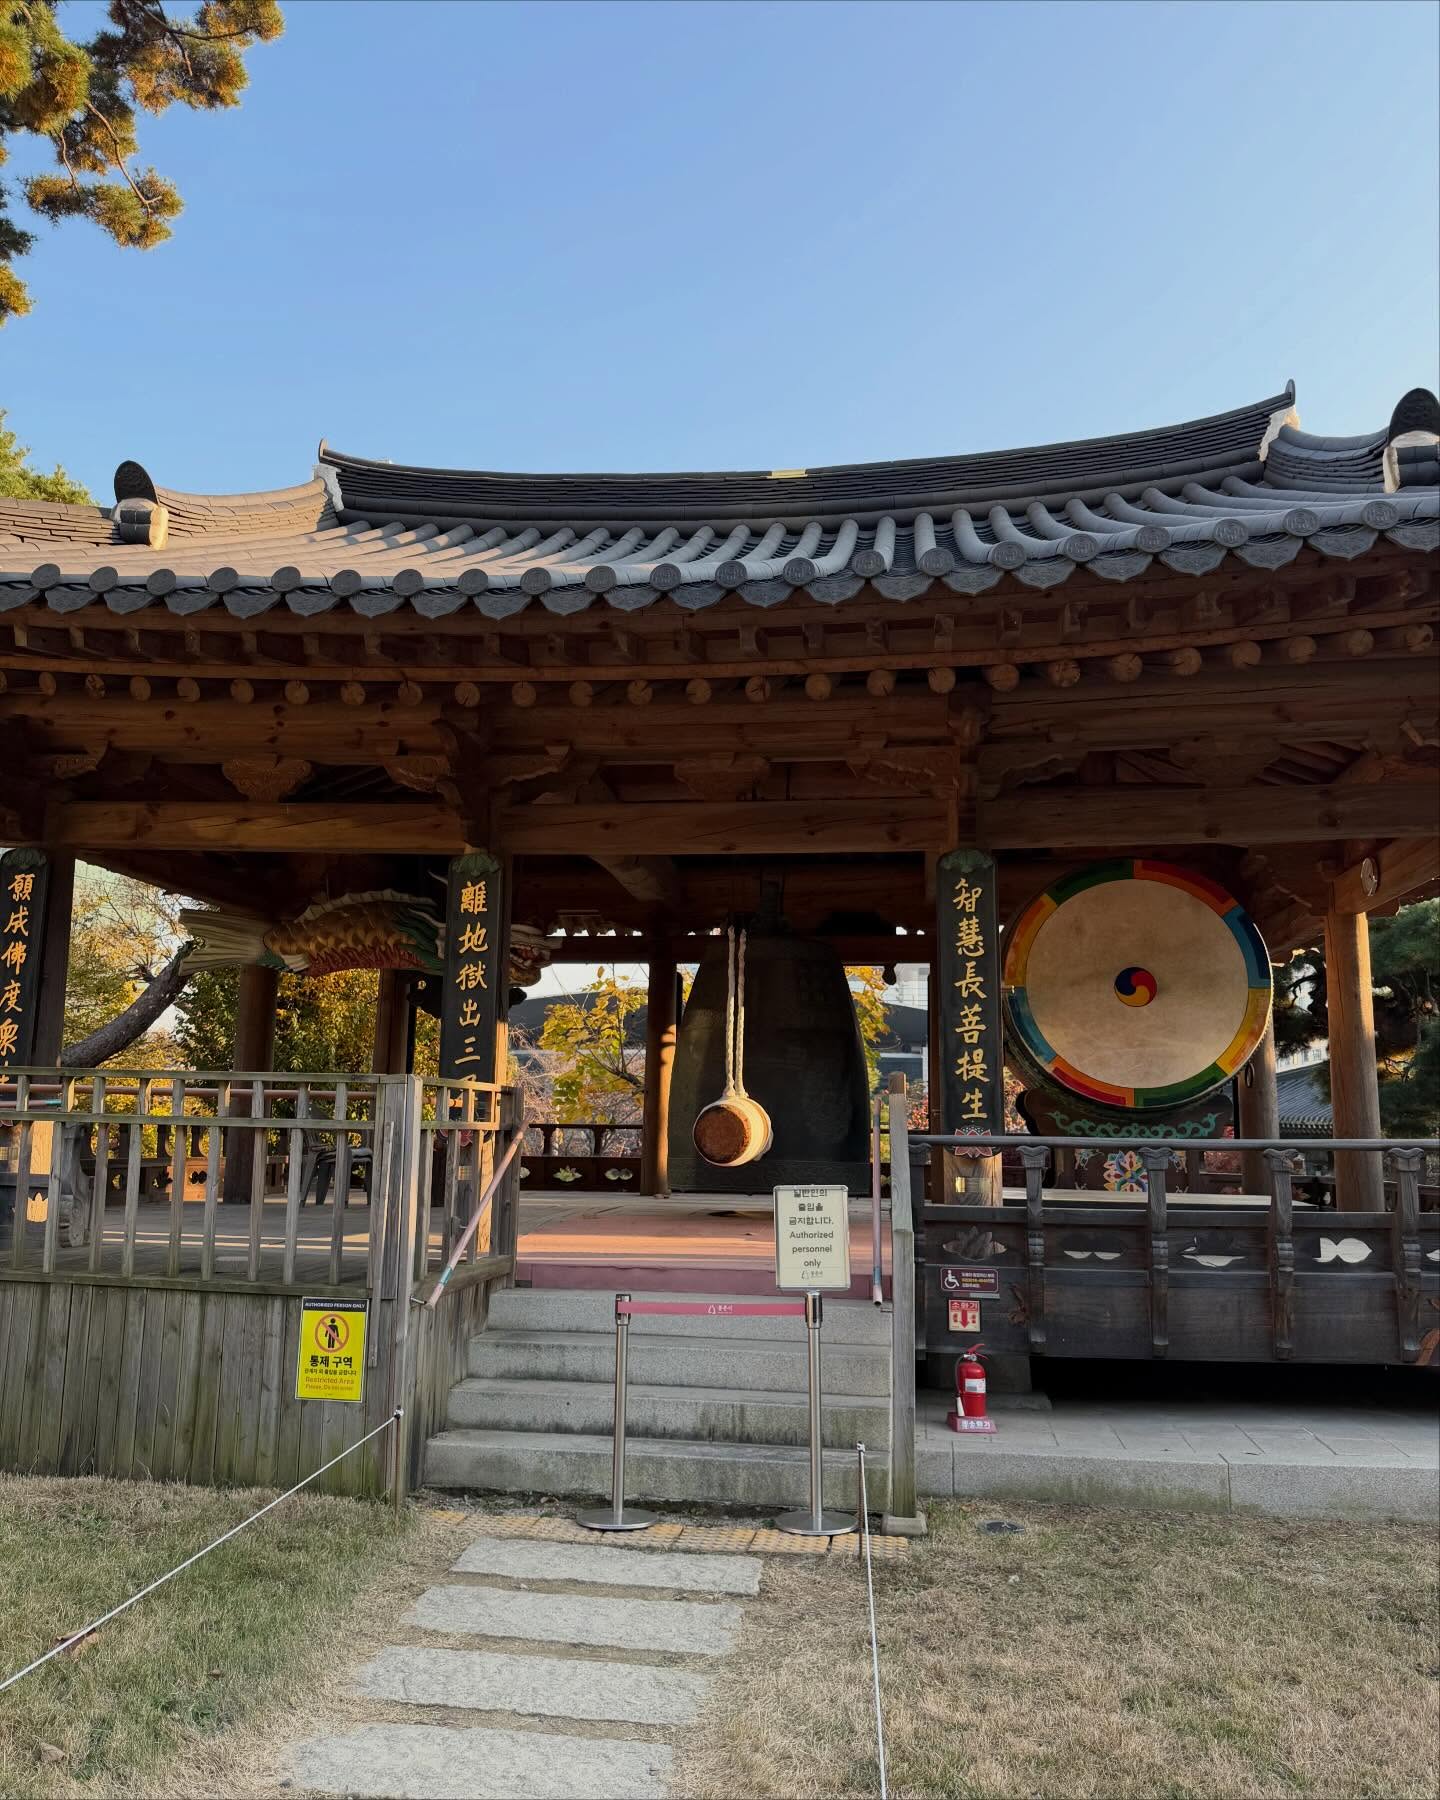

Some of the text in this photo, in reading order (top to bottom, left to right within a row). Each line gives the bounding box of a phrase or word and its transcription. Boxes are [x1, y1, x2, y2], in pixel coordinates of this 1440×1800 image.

[455, 881, 488, 1100] 離地獄出三
[953, 878, 990, 1120] 智慧長菩提生
[789, 1216, 834, 1225] 금지합니다.
[789, 1231, 834, 1239] Authorized
[792, 1245, 833, 1254] personnel
[803, 1259, 821, 1268] only
[951, 1302, 978, 1310] 소화기
[309, 1355, 353, 1369] 통제 구역
[305, 1376, 338, 1384] Restricted
